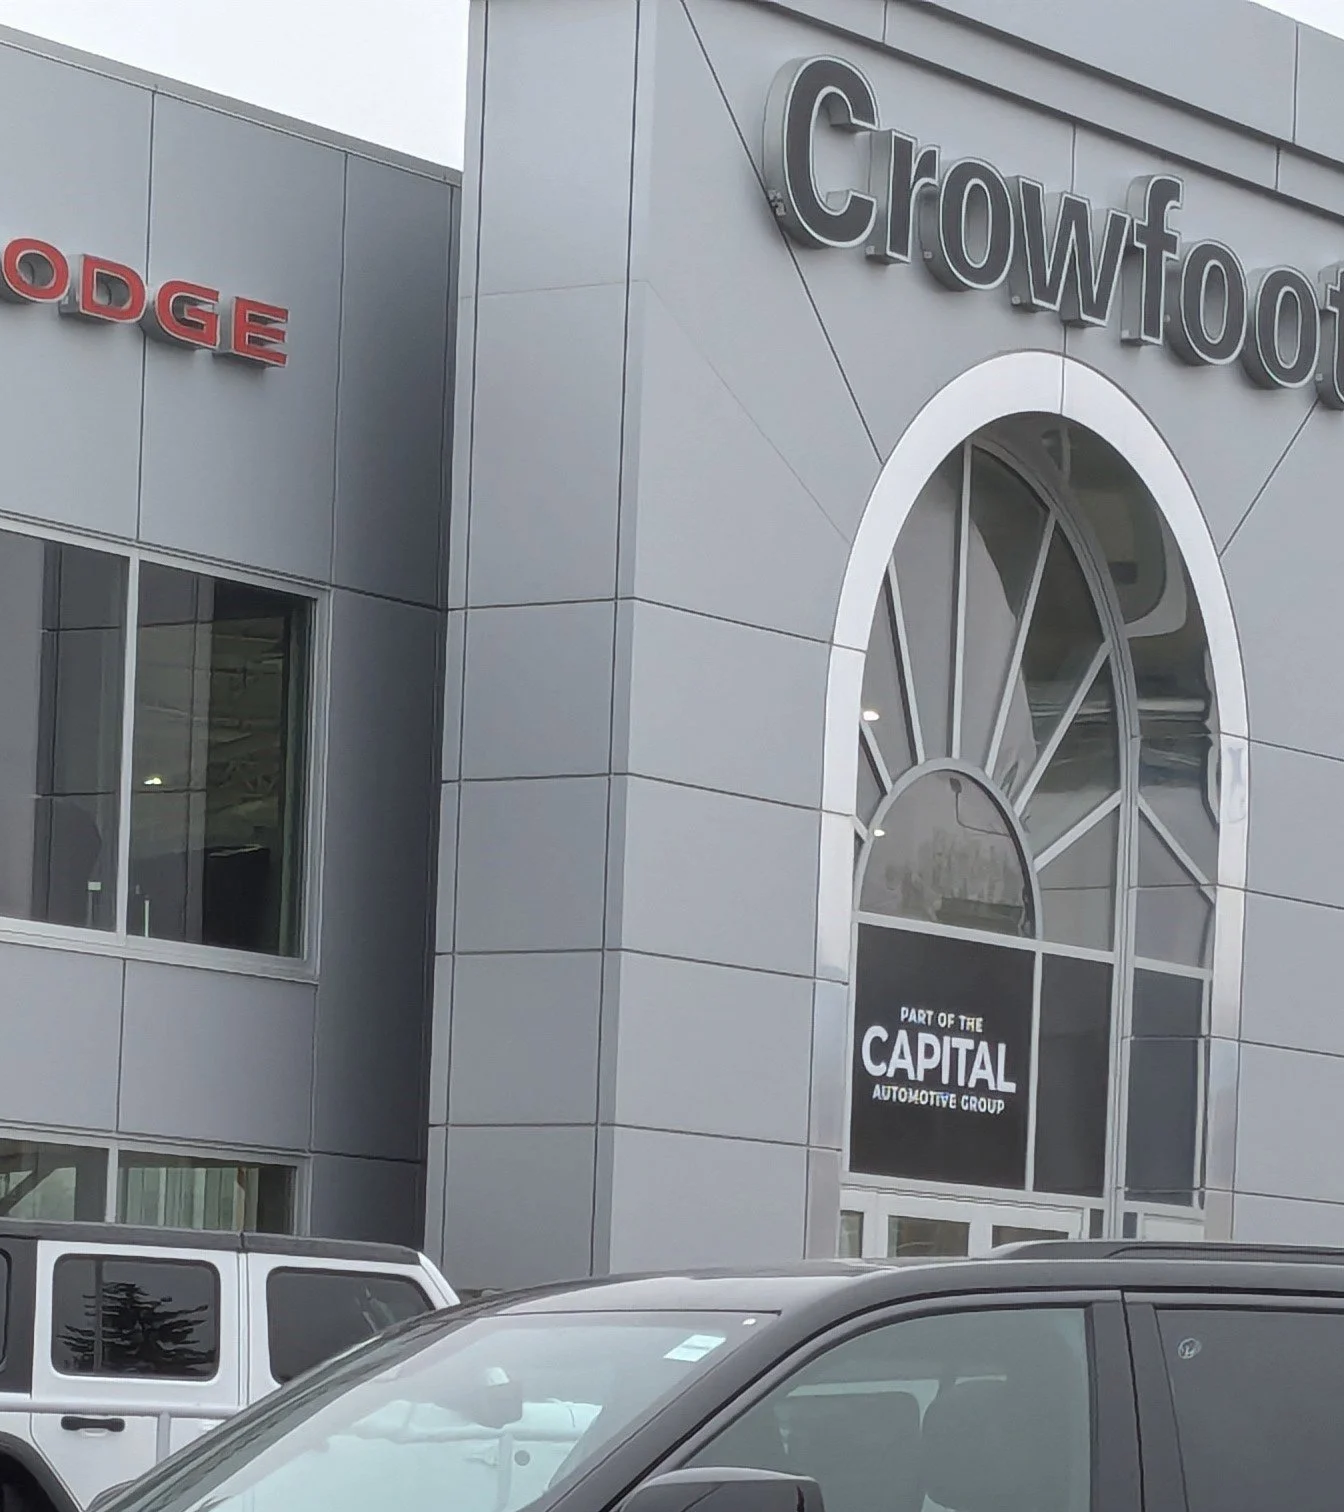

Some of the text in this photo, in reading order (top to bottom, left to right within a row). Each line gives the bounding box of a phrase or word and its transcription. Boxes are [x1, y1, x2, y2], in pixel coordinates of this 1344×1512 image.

[900, 1006, 984, 1033] PART OF THE
[861, 1025, 1017, 1094] CAPITAL
[872, 1083, 1005, 1115] AUTOMOTIVE GROUP
